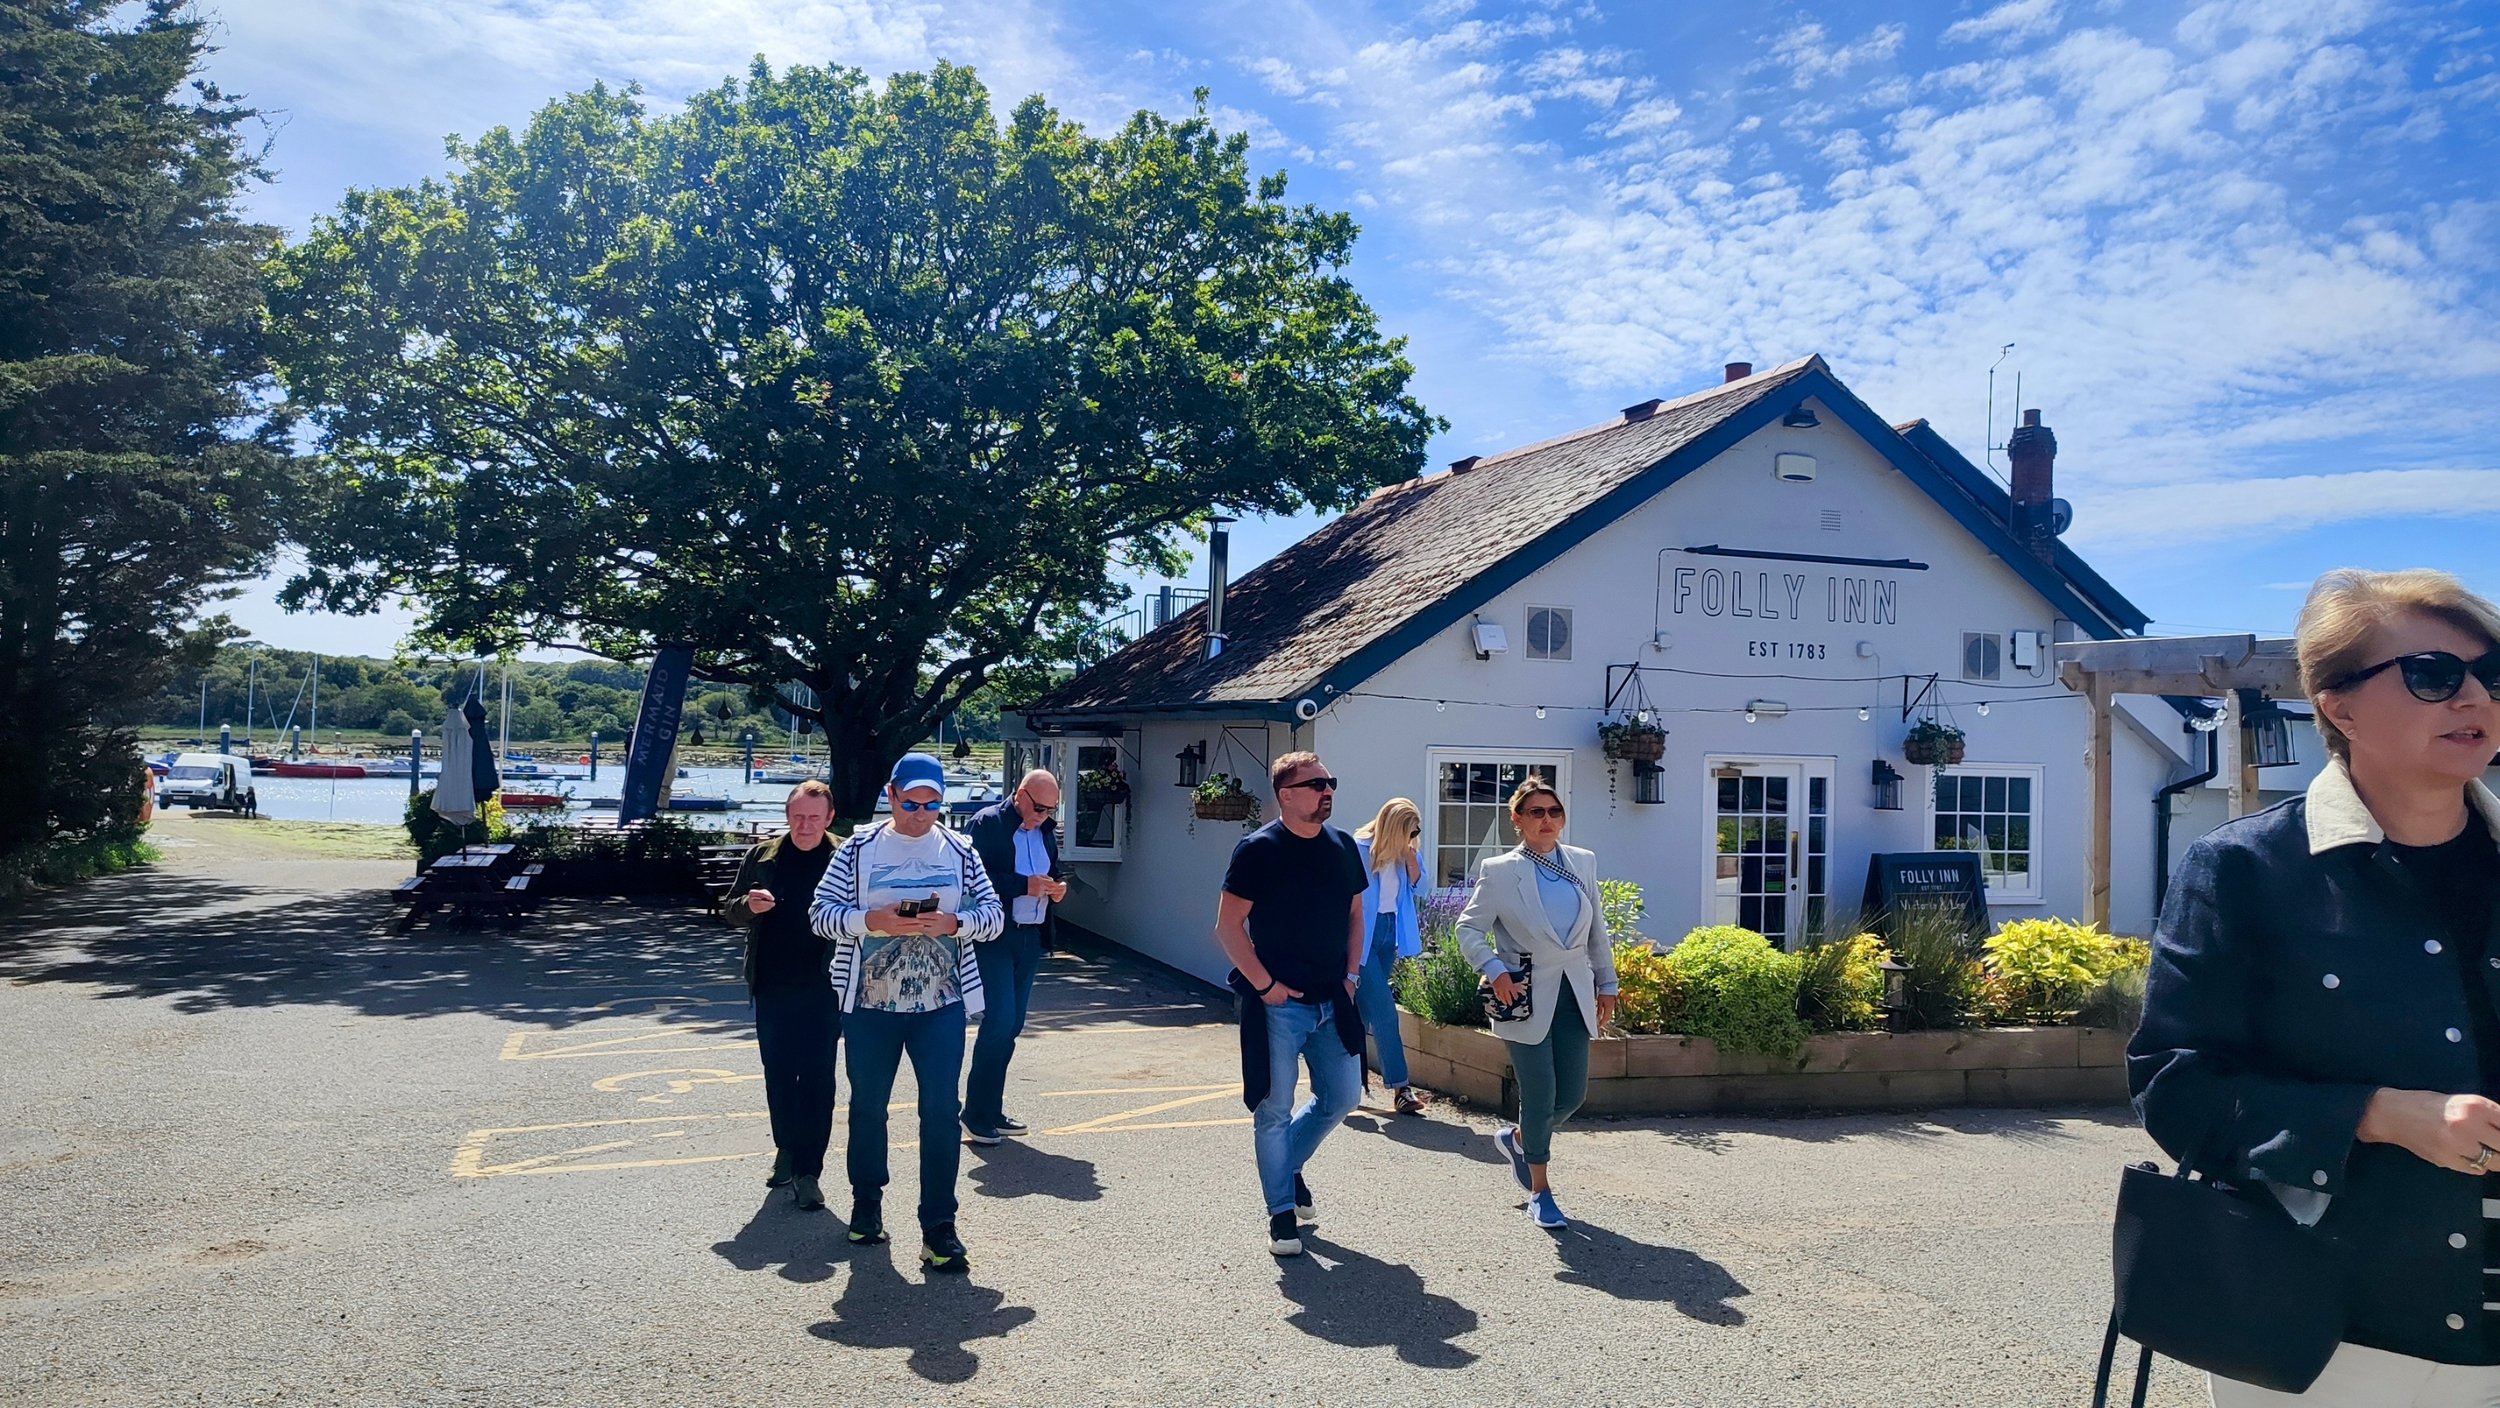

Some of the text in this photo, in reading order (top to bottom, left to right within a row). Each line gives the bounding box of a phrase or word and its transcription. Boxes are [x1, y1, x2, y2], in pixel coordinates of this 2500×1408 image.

[1673, 567, 1896, 625] FOLLY INN
[1749, 641, 1826, 660] EST 1783
[638, 669, 669, 765] MERMAID
[659, 706, 677, 740] GIN
[1900, 869, 1960, 884] FOLLY INN
